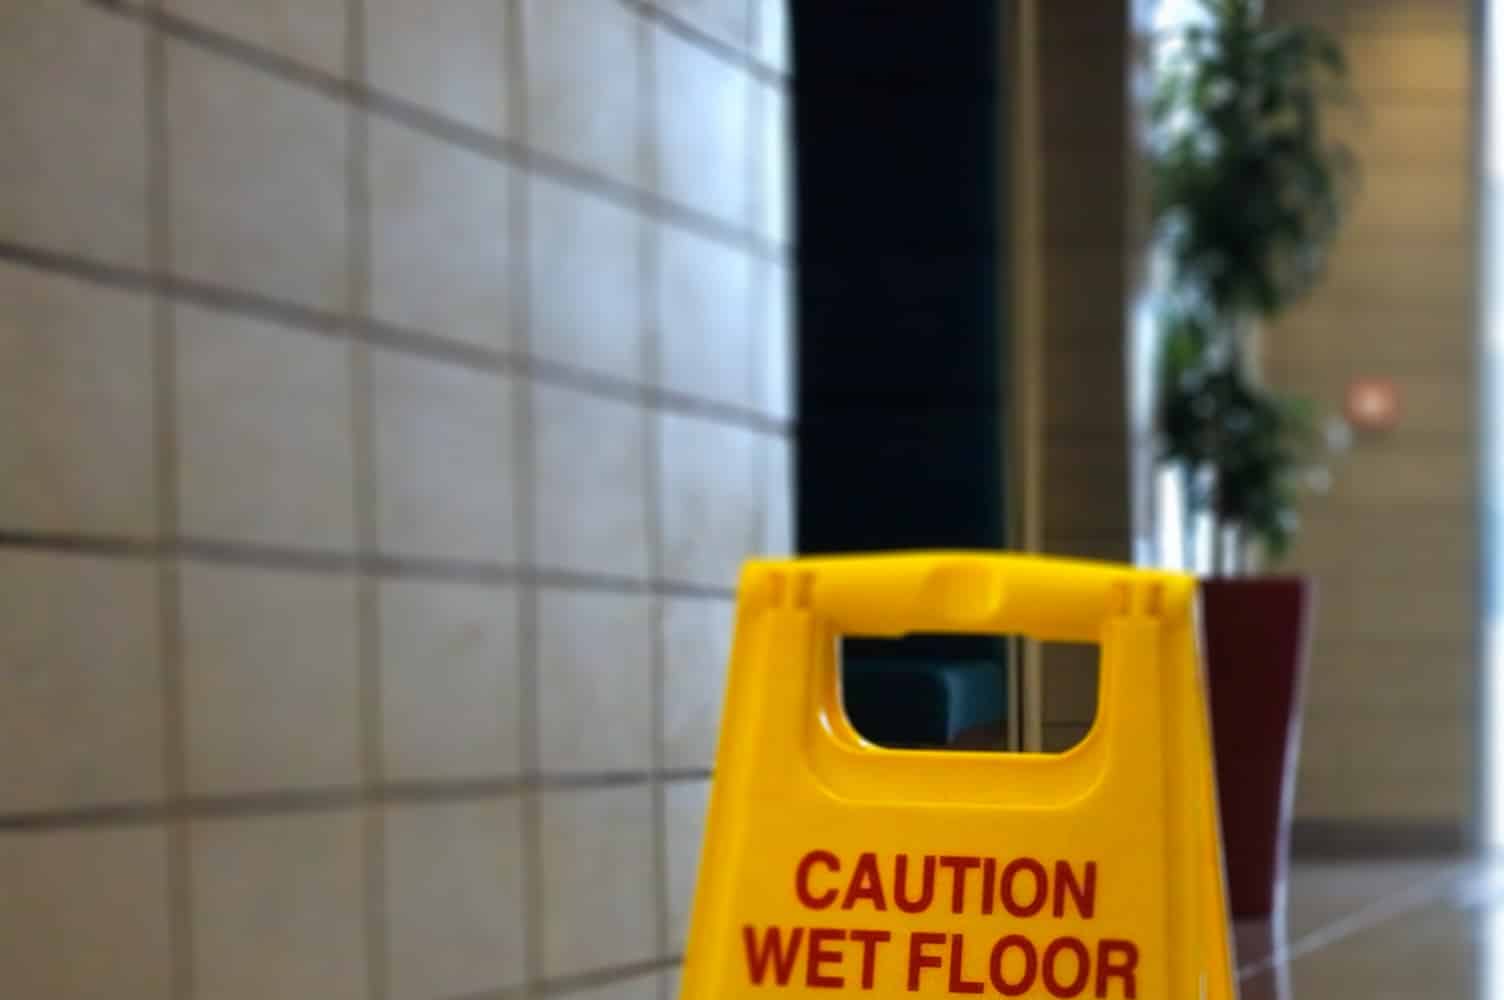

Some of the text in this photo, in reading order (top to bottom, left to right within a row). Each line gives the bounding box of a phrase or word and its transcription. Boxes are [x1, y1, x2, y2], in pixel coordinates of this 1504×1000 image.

[794, 849, 1097, 920] CAUTION
[741, 925, 1141, 1000] WET FLOOR
